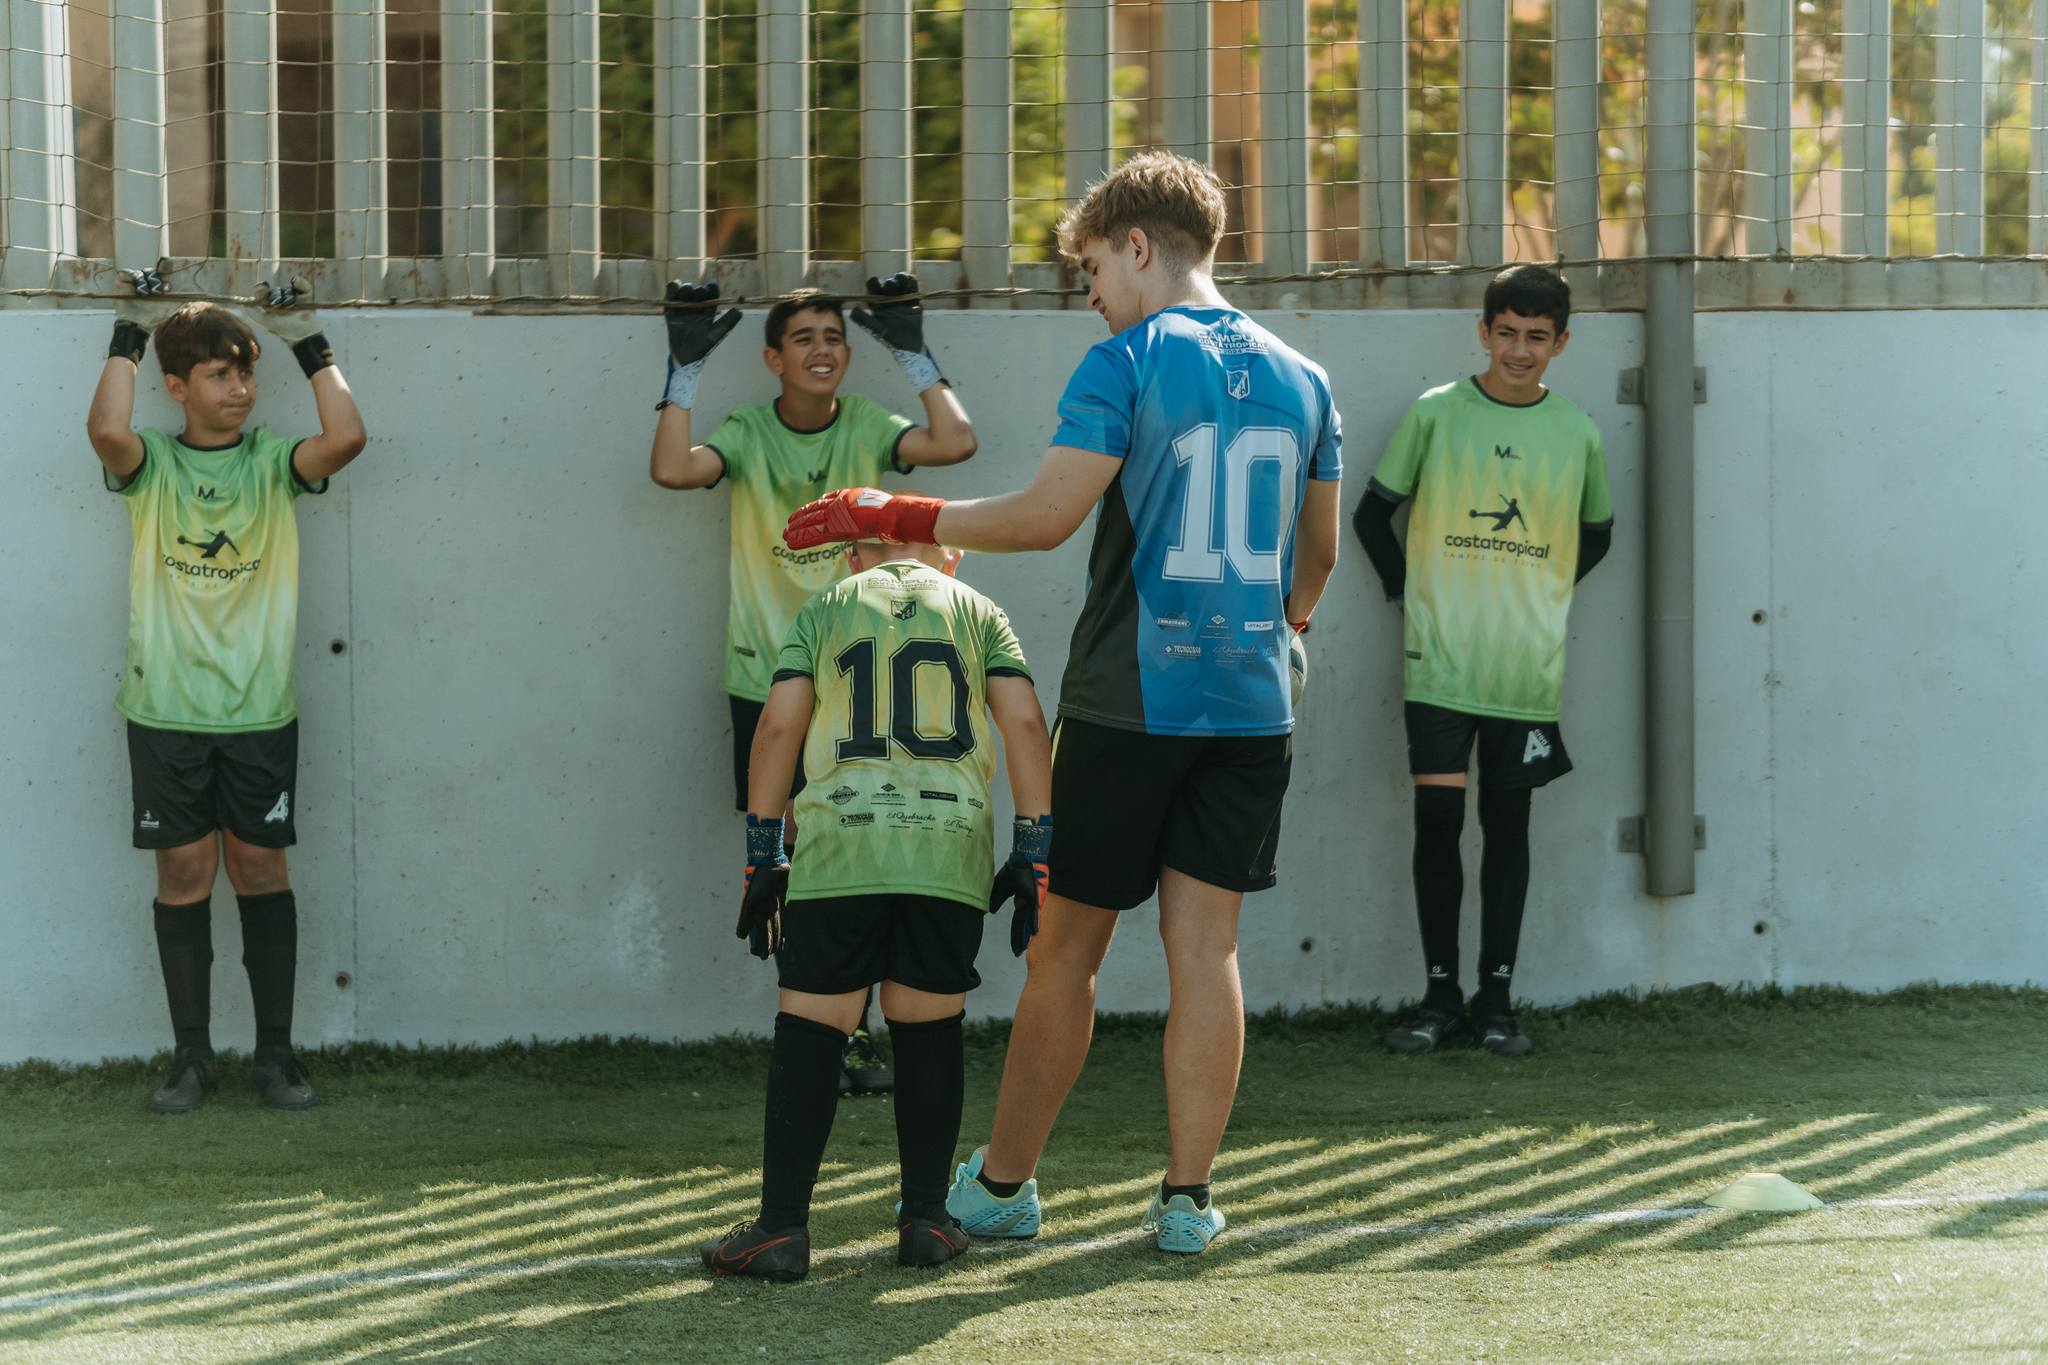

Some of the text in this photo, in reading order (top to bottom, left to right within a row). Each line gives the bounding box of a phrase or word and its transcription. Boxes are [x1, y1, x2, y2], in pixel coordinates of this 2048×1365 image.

[1162, 422, 1301, 584] 10
[1444, 535, 1550, 559] costatropical
[833, 637, 977, 764] 10
